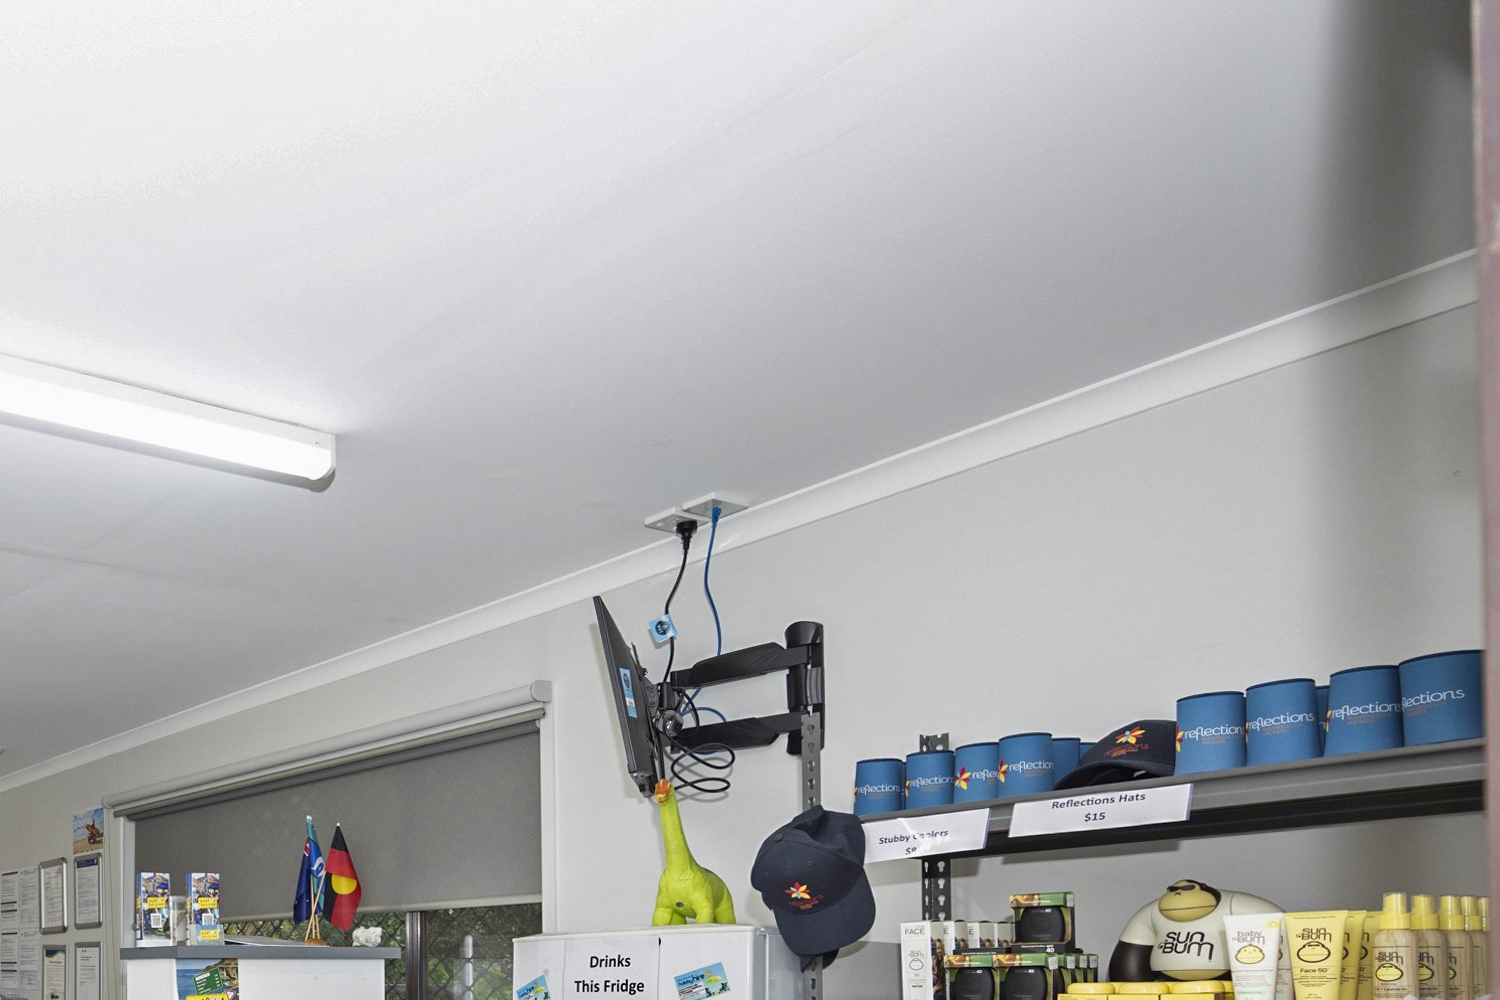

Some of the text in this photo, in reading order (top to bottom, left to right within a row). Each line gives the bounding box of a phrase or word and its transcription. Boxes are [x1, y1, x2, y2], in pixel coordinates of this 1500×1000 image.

[1249, 711, 1315, 735] reflections
[1051, 792, 1146, 810] Reflections Hats
[1084, 812, 1106, 823] $15
[879, 835, 911, 845] Stubby
[904, 928, 925, 936] FACE
[1237, 930, 1262, 938] baby
[589, 954, 631, 968] Drinks
[574, 979, 645, 995] This Fridge
